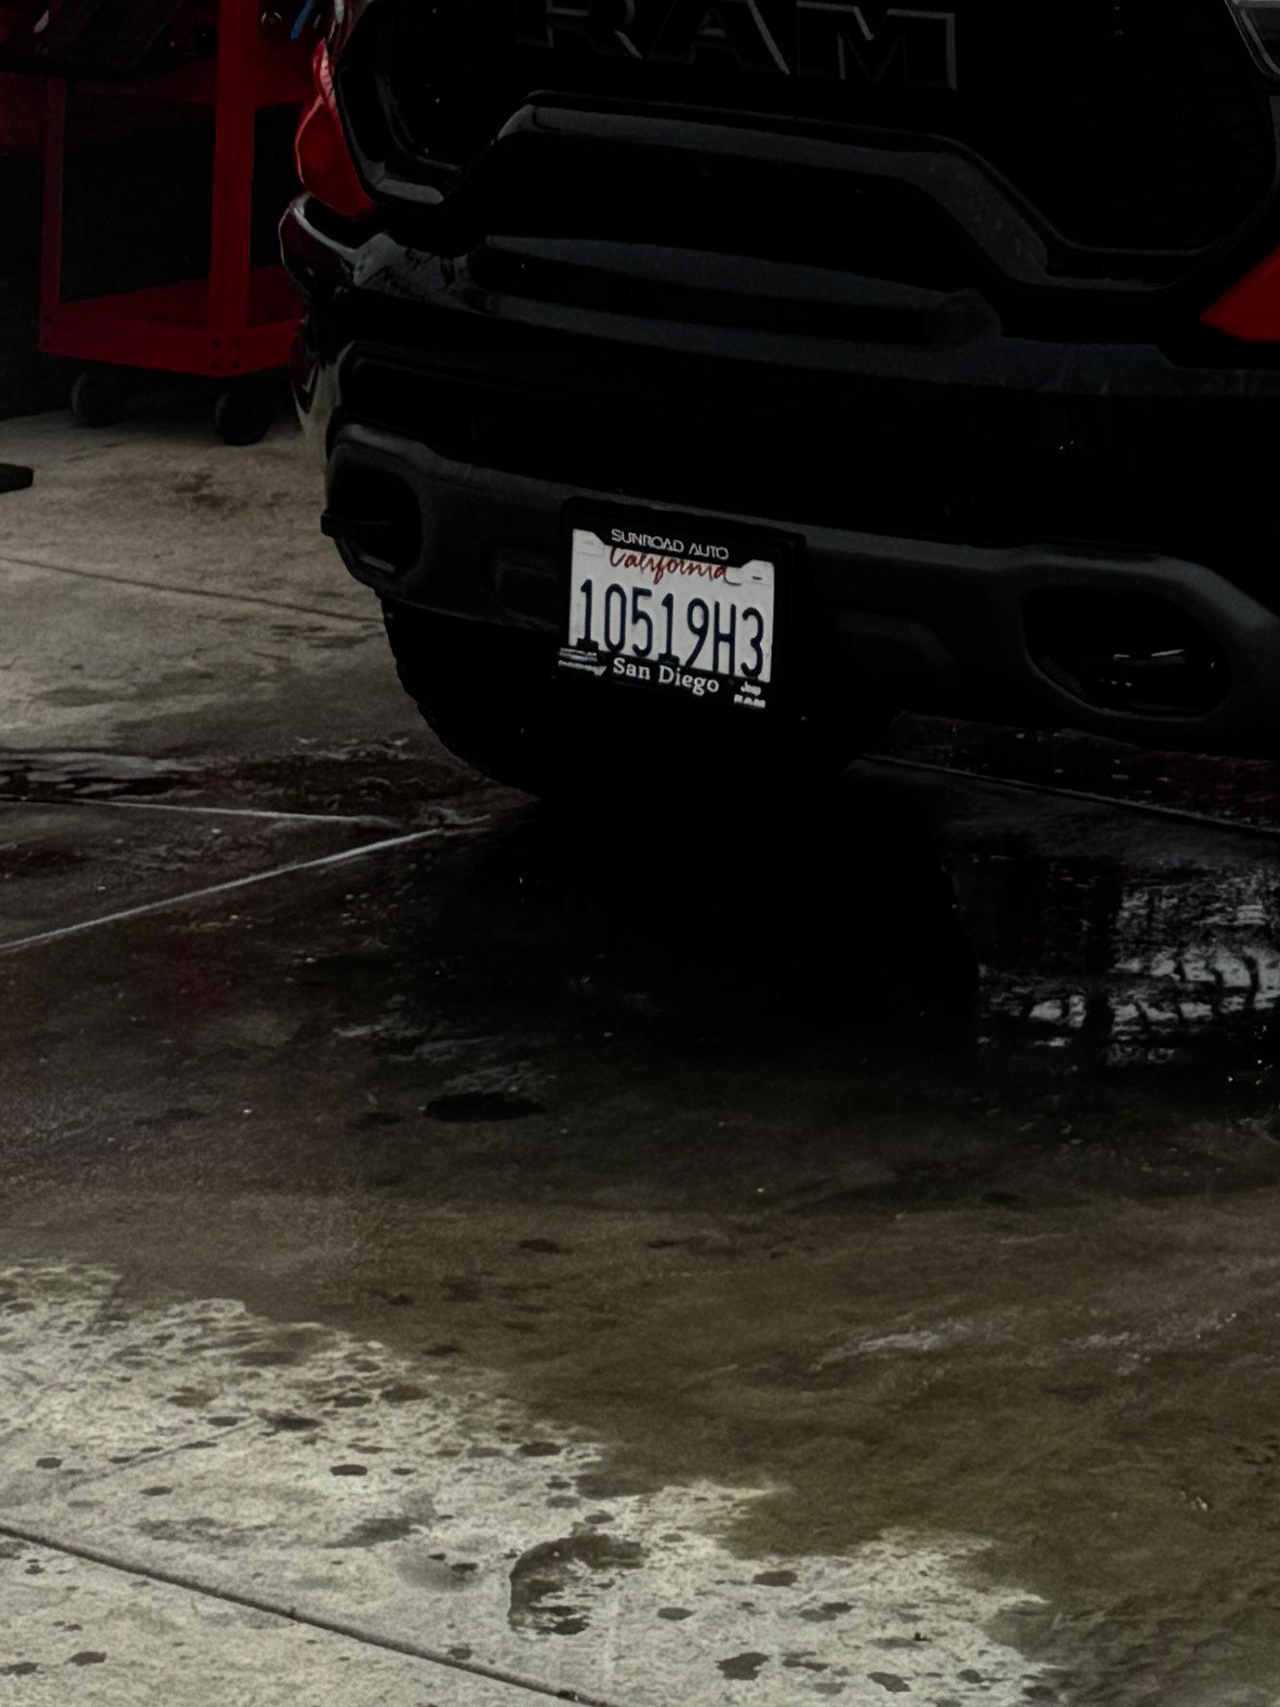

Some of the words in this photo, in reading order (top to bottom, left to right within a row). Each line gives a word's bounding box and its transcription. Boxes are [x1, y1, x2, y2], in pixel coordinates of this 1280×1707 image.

[610, 528, 685, 554] SUNROAD
[688, 542, 729, 561] AUTO
[580, 578, 764, 678] 10519H3
[613, 657, 650, 681] San
[659, 664, 719, 696] Diego
